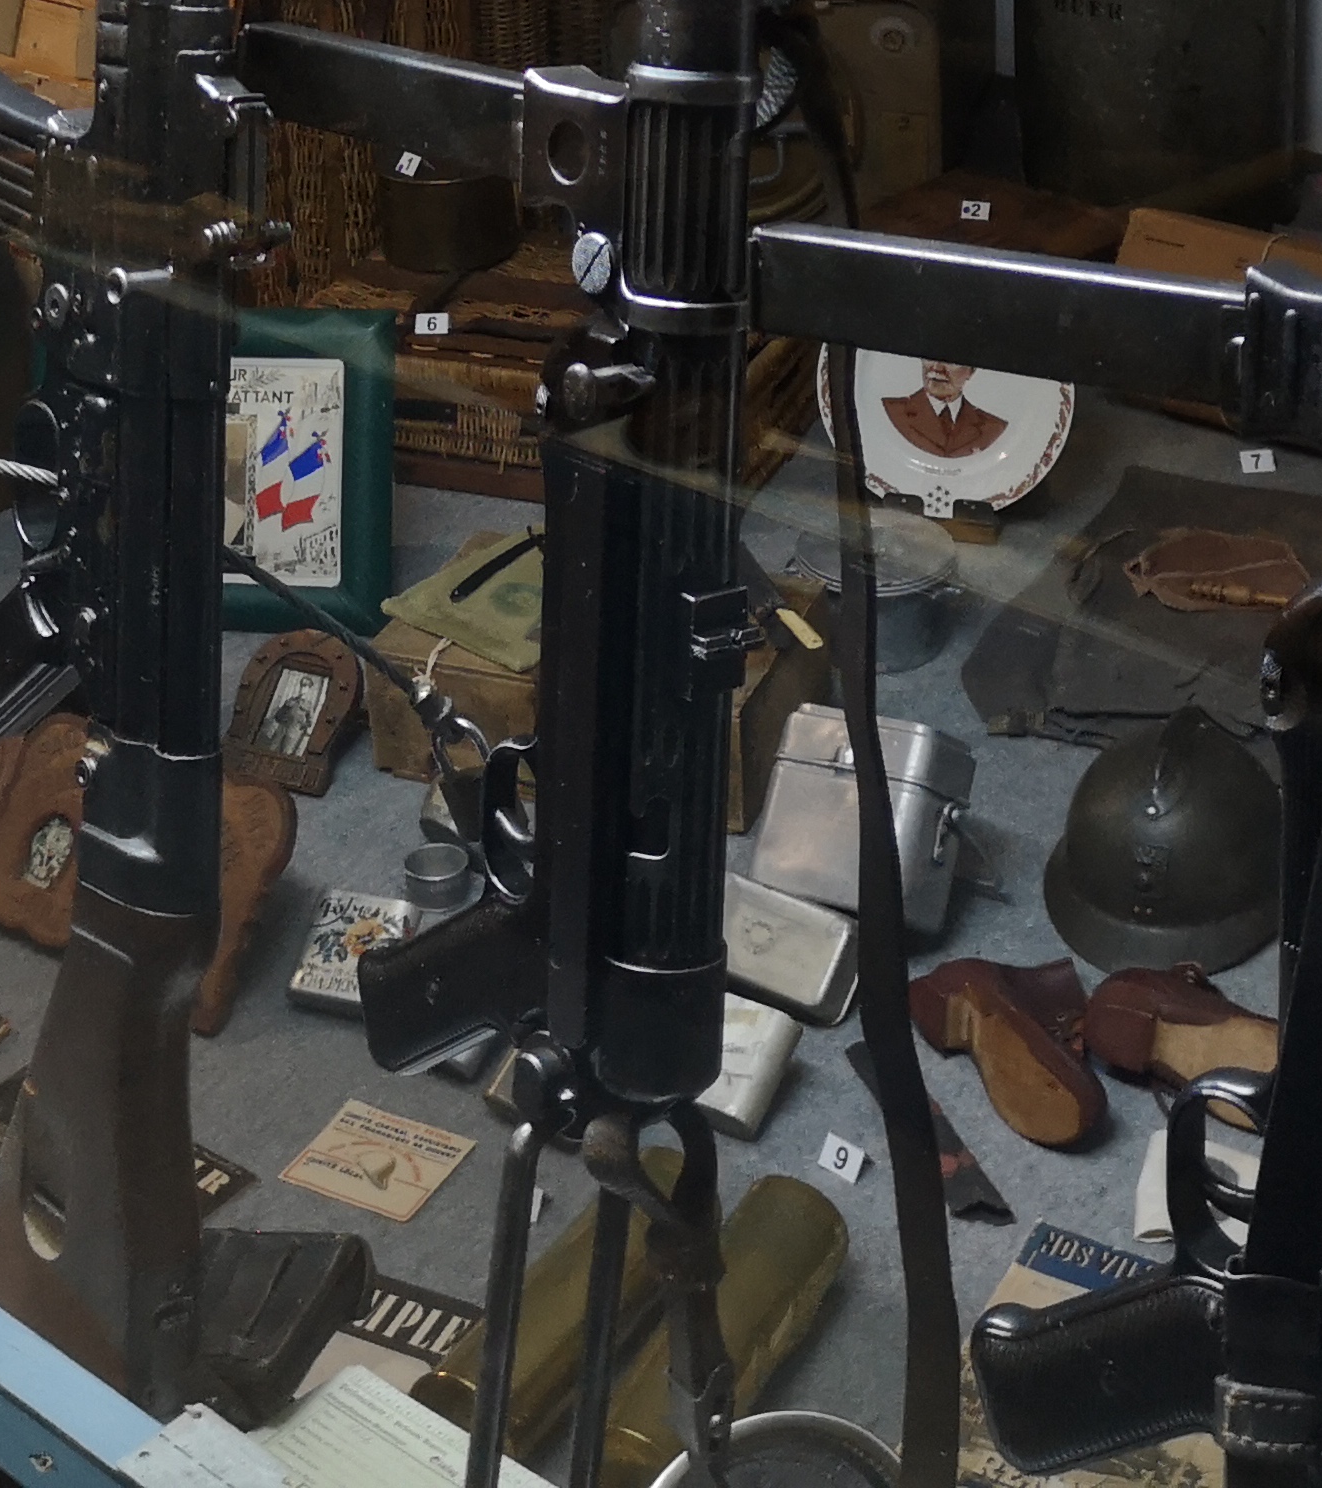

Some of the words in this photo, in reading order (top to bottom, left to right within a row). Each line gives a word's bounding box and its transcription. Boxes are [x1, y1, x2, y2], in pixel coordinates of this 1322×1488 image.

[971, 203, 981, 217] 2
[427, 316, 437, 331] 6
[1250, 453, 1261, 470] 7
[834, 1146, 848, 1170] 9
